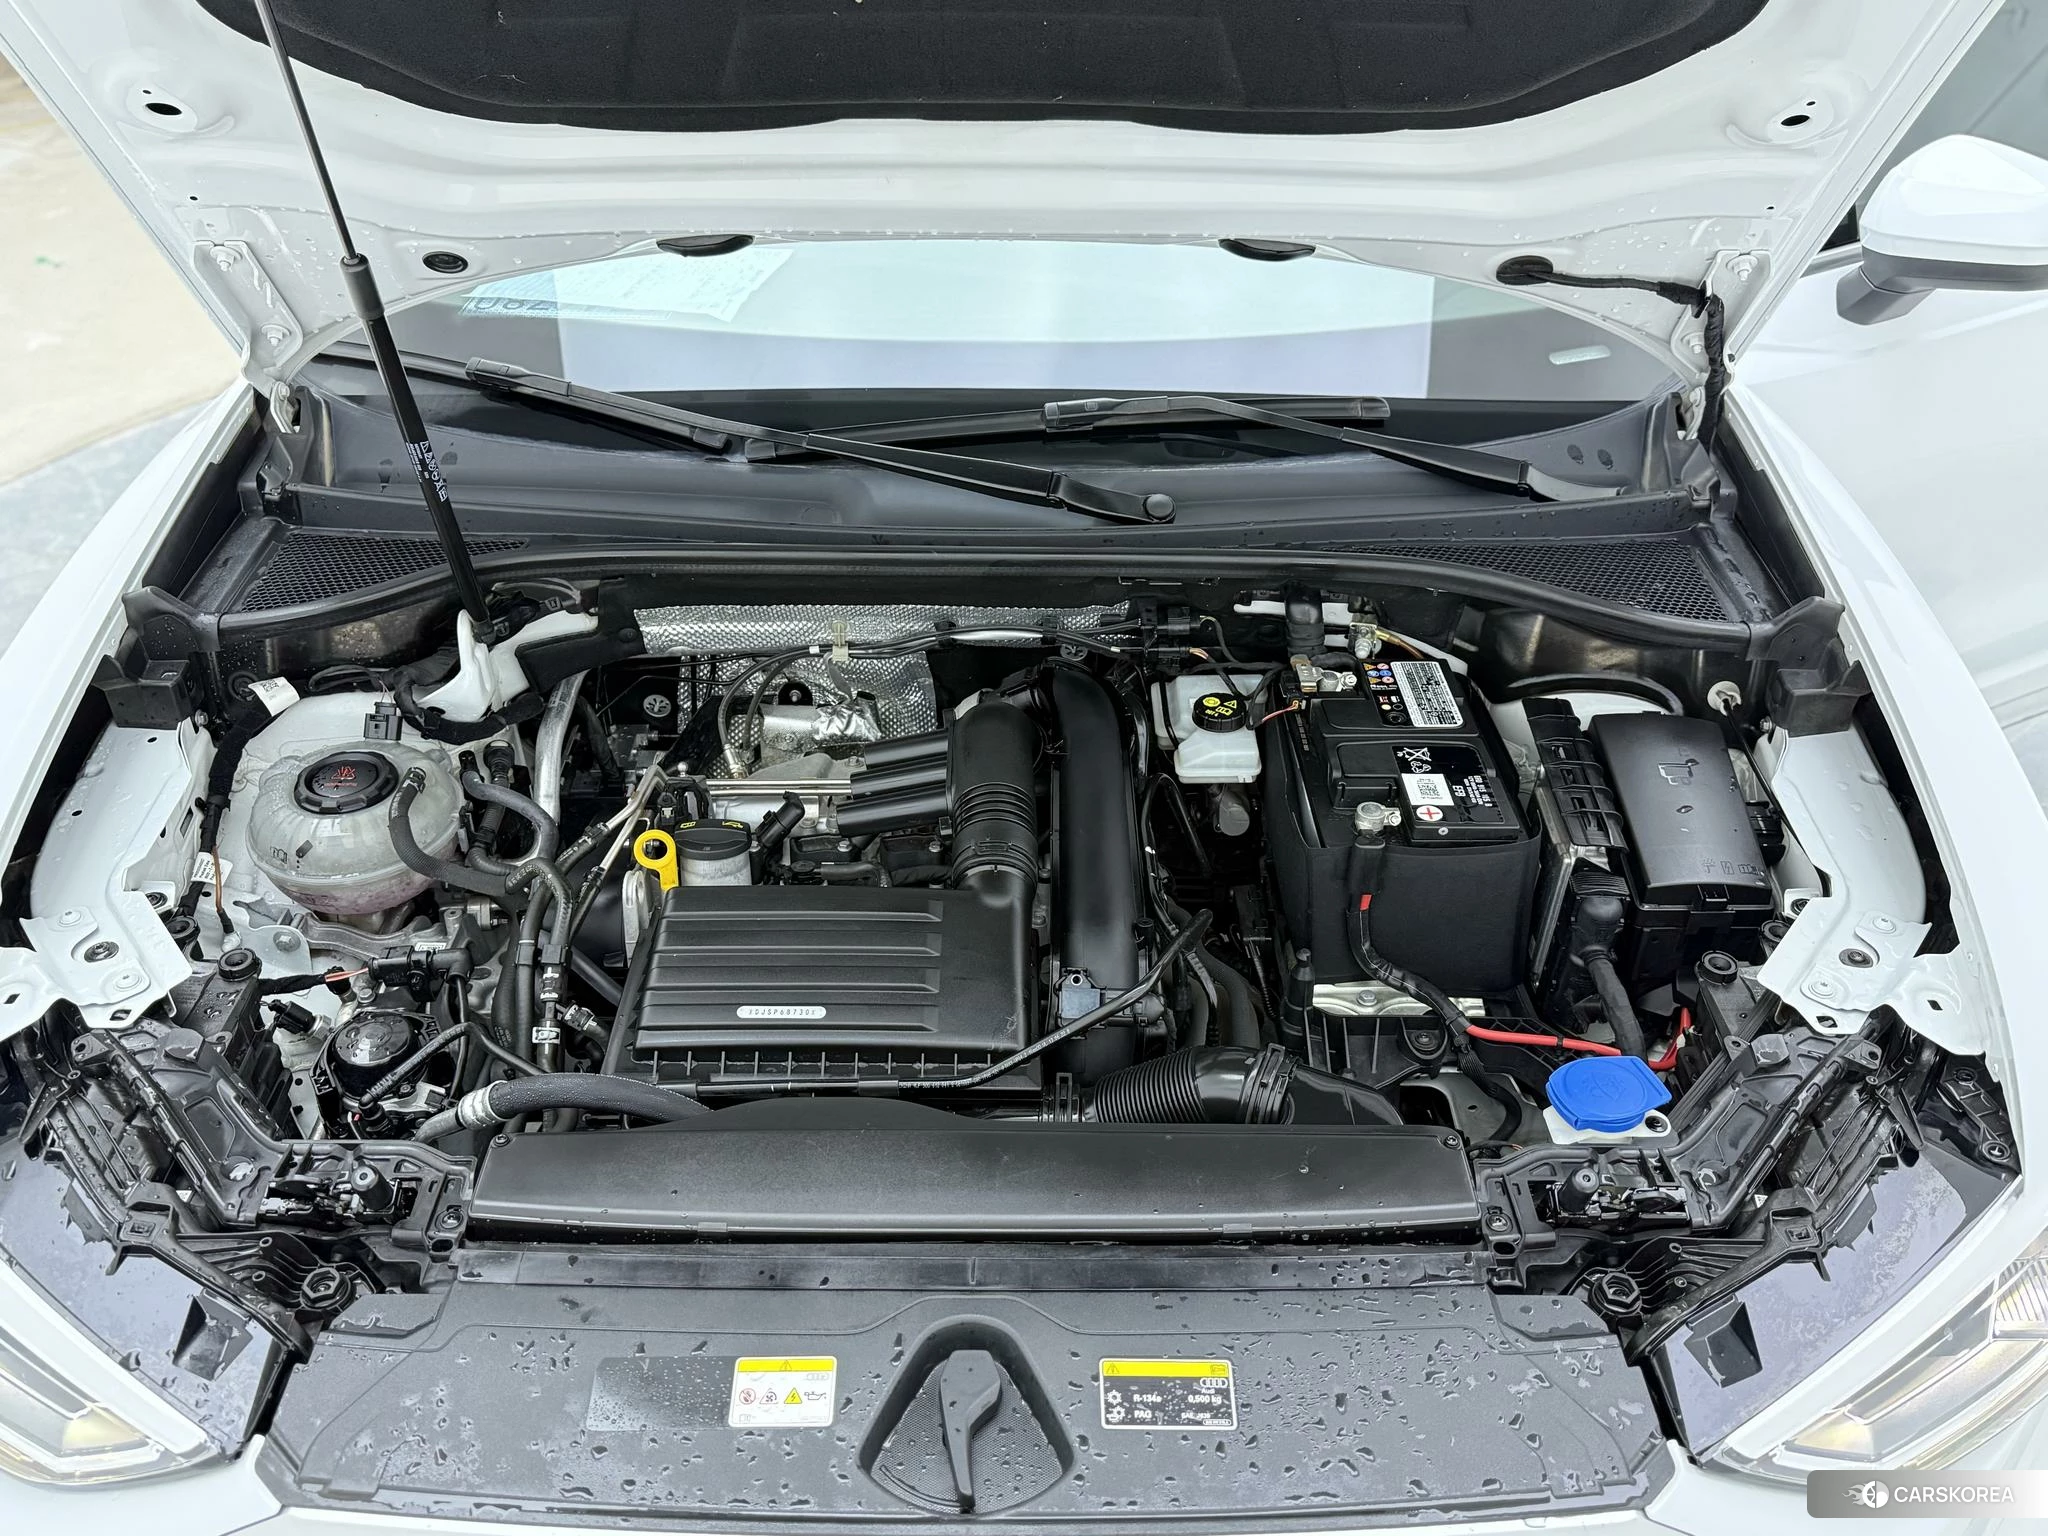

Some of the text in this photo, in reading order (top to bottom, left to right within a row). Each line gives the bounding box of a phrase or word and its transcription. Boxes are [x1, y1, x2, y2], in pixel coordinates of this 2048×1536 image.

[1187, 1394, 1210, 1404] 0,500
[1211, 1394, 1222, 1405] kg
[1134, 1410, 1152, 1418] PAG
